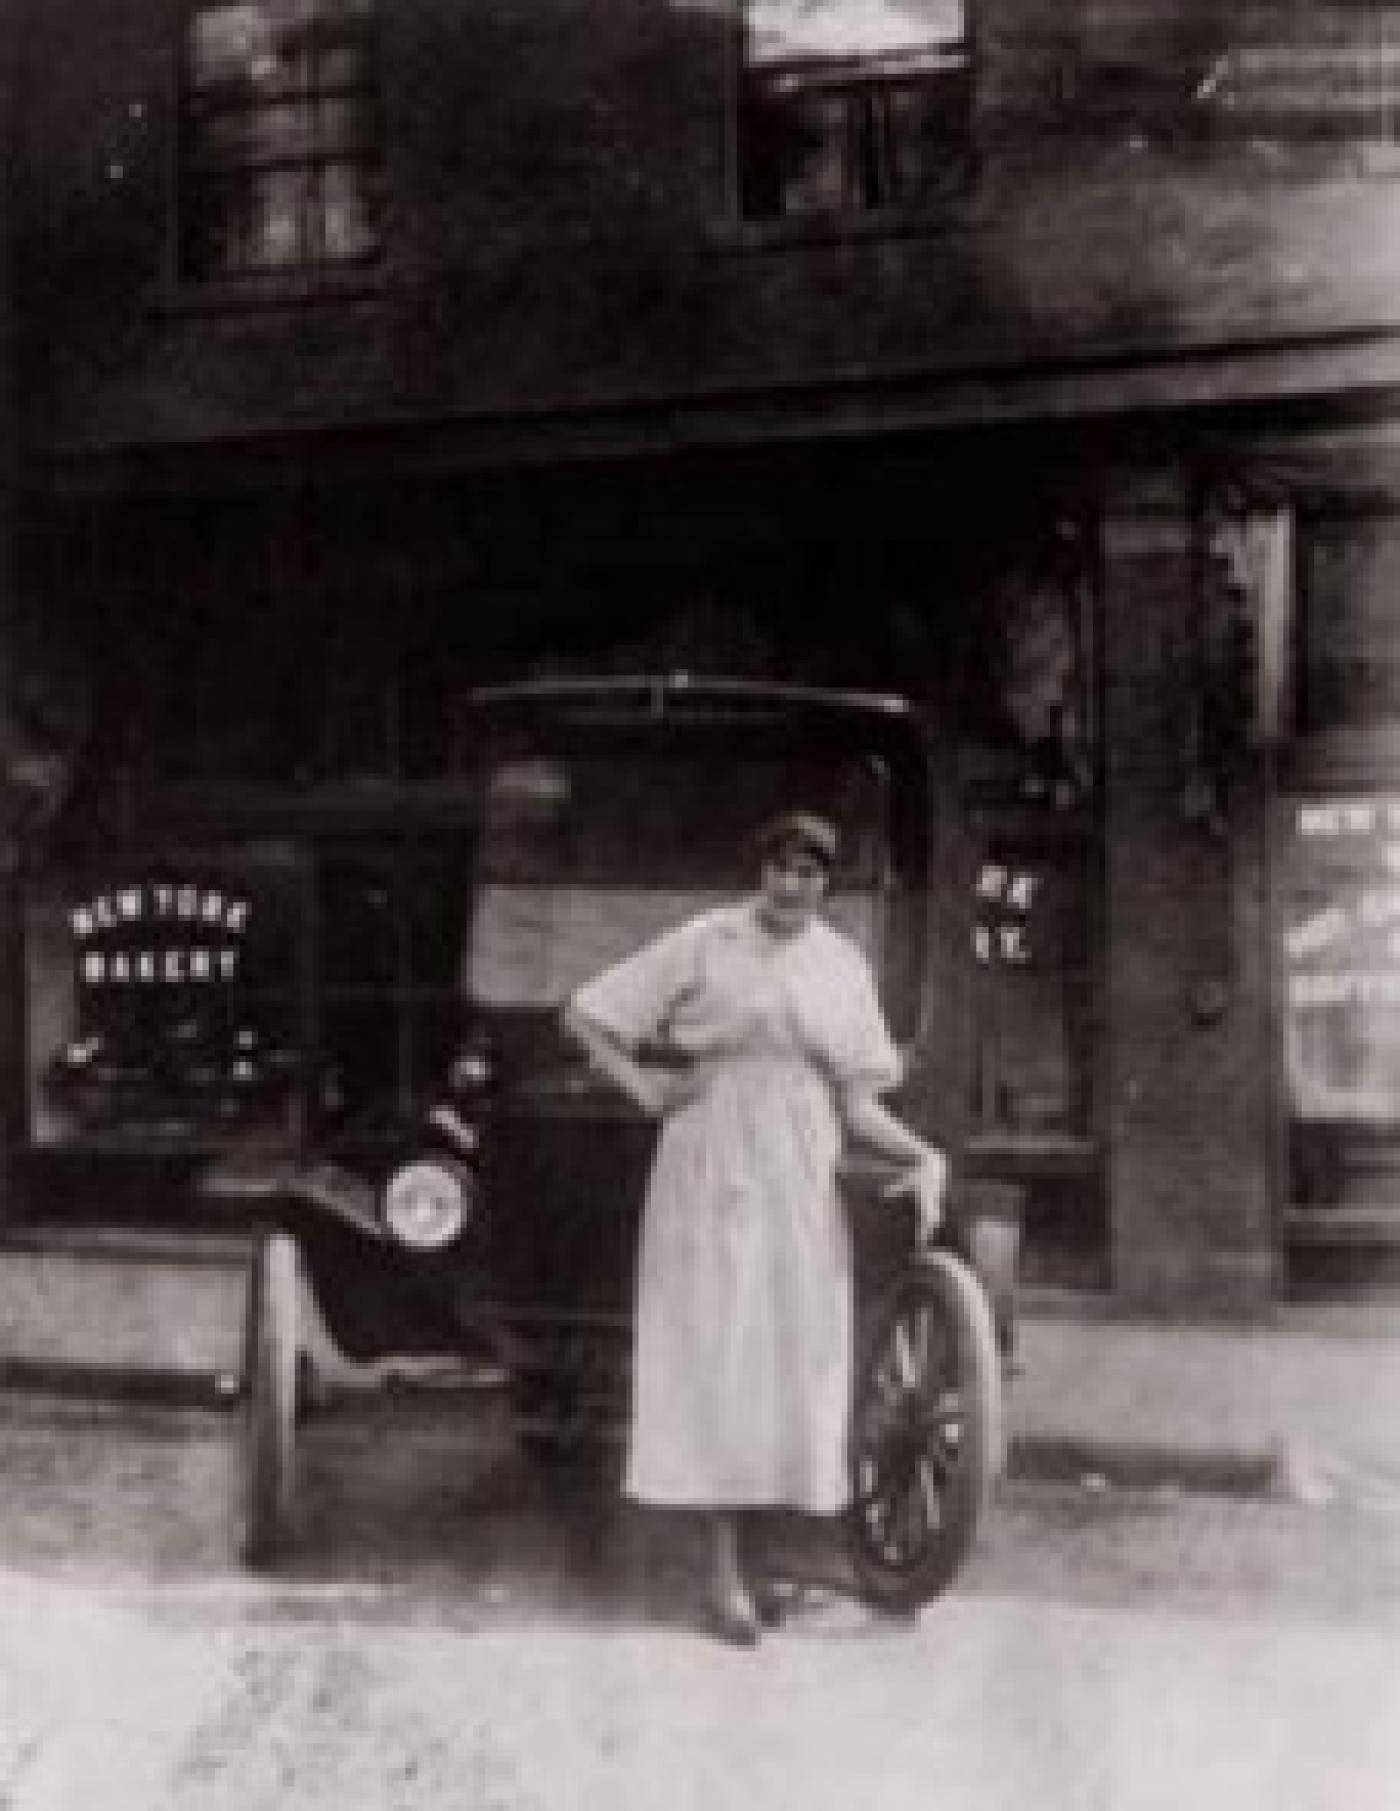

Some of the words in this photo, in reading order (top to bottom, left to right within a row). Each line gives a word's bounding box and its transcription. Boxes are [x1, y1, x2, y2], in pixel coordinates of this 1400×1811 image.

[70, 886, 142, 936] NEW
[153, 884, 249, 933] YORK
[84, 949, 237, 983] BAKERY
